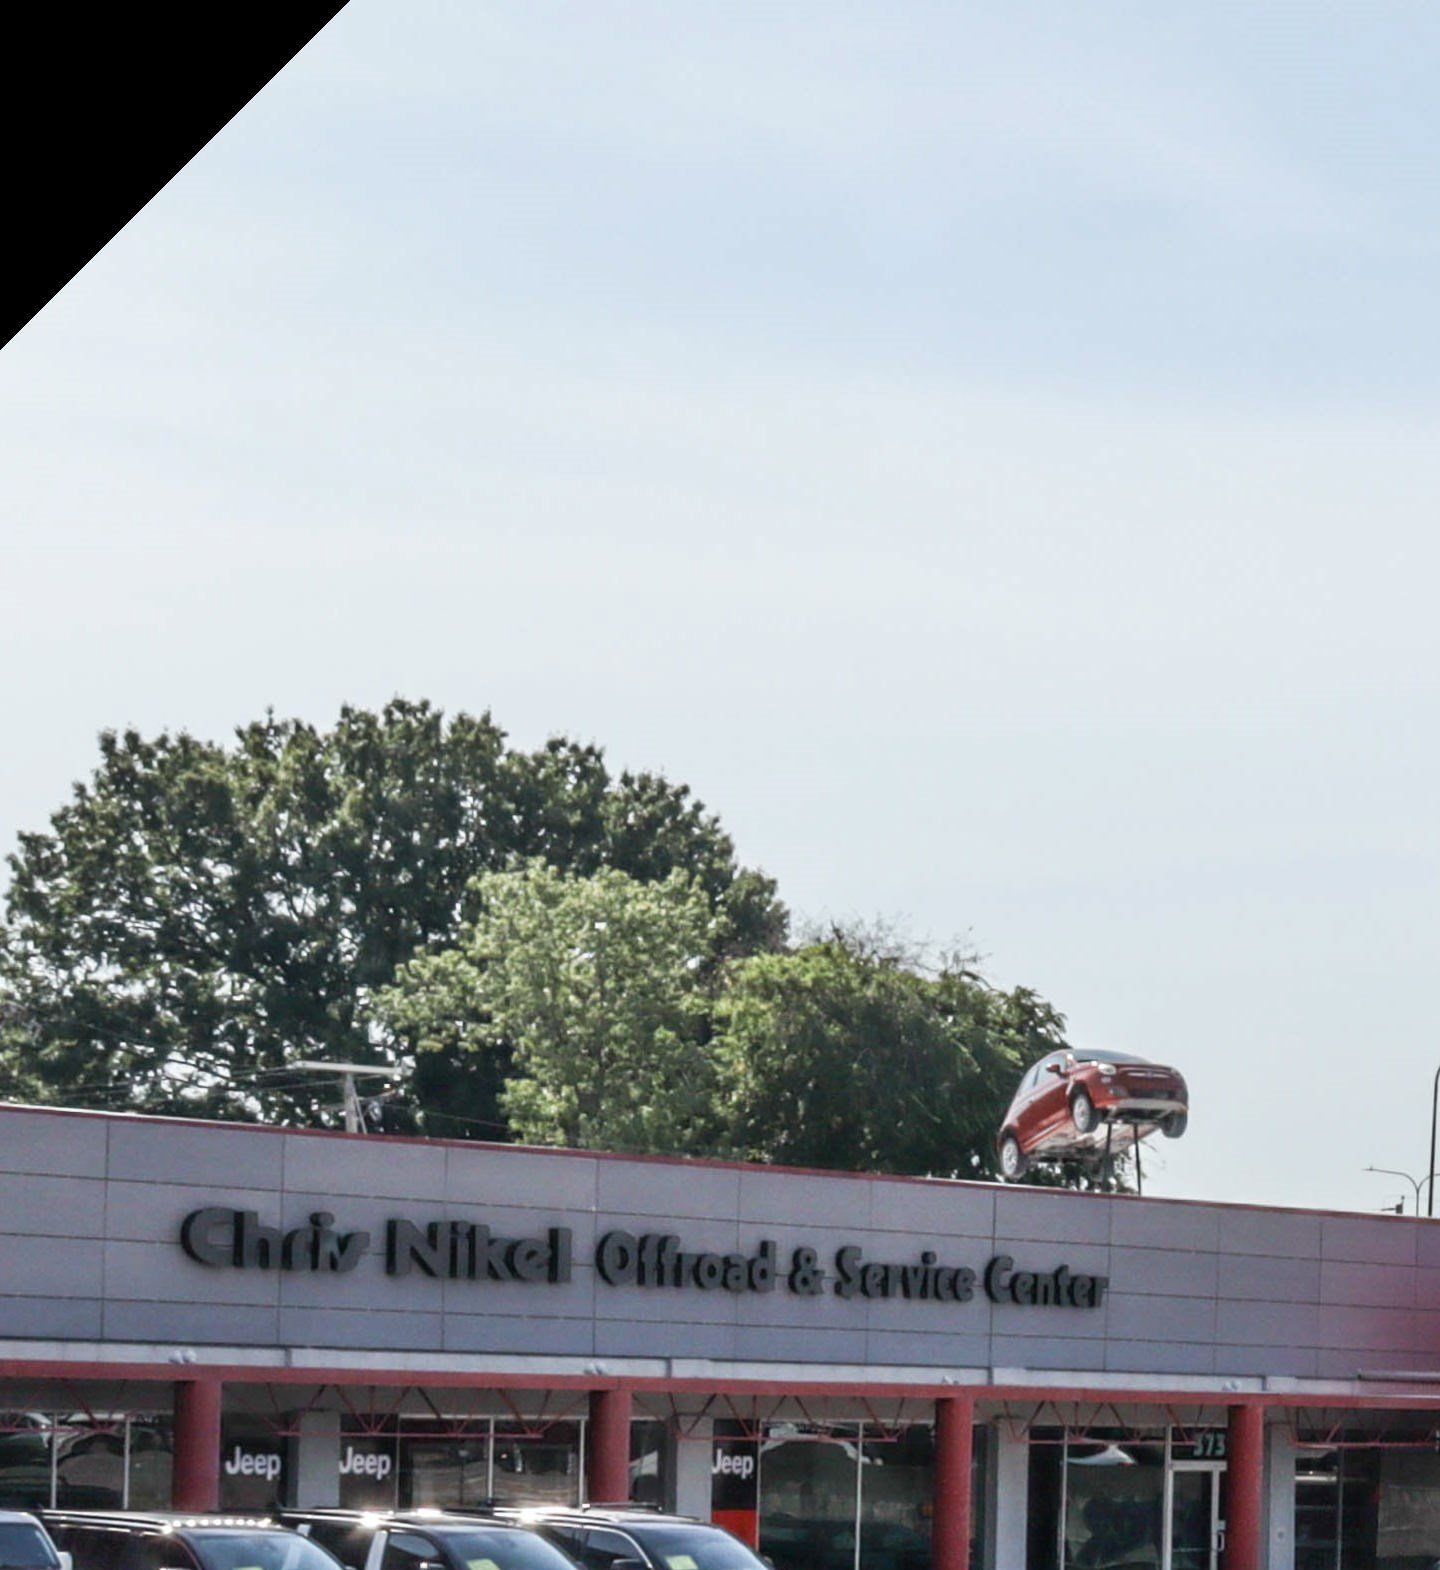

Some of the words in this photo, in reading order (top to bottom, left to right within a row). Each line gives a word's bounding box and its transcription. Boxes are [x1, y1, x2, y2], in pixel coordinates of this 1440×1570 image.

[181, 1207, 370, 1272] Chris
[386, 1219, 572, 1284] Nikel
[596, 1230, 775, 1294] Offroad
[788, 1247, 825, 1295] &
[835, 1246, 975, 1301] Service
[984, 1255, 1109, 1308] Center
[225, 1446, 282, 1481] Jeep
[339, 1446, 391, 1480] Jeep
[711, 1448, 754, 1479] Jeep
